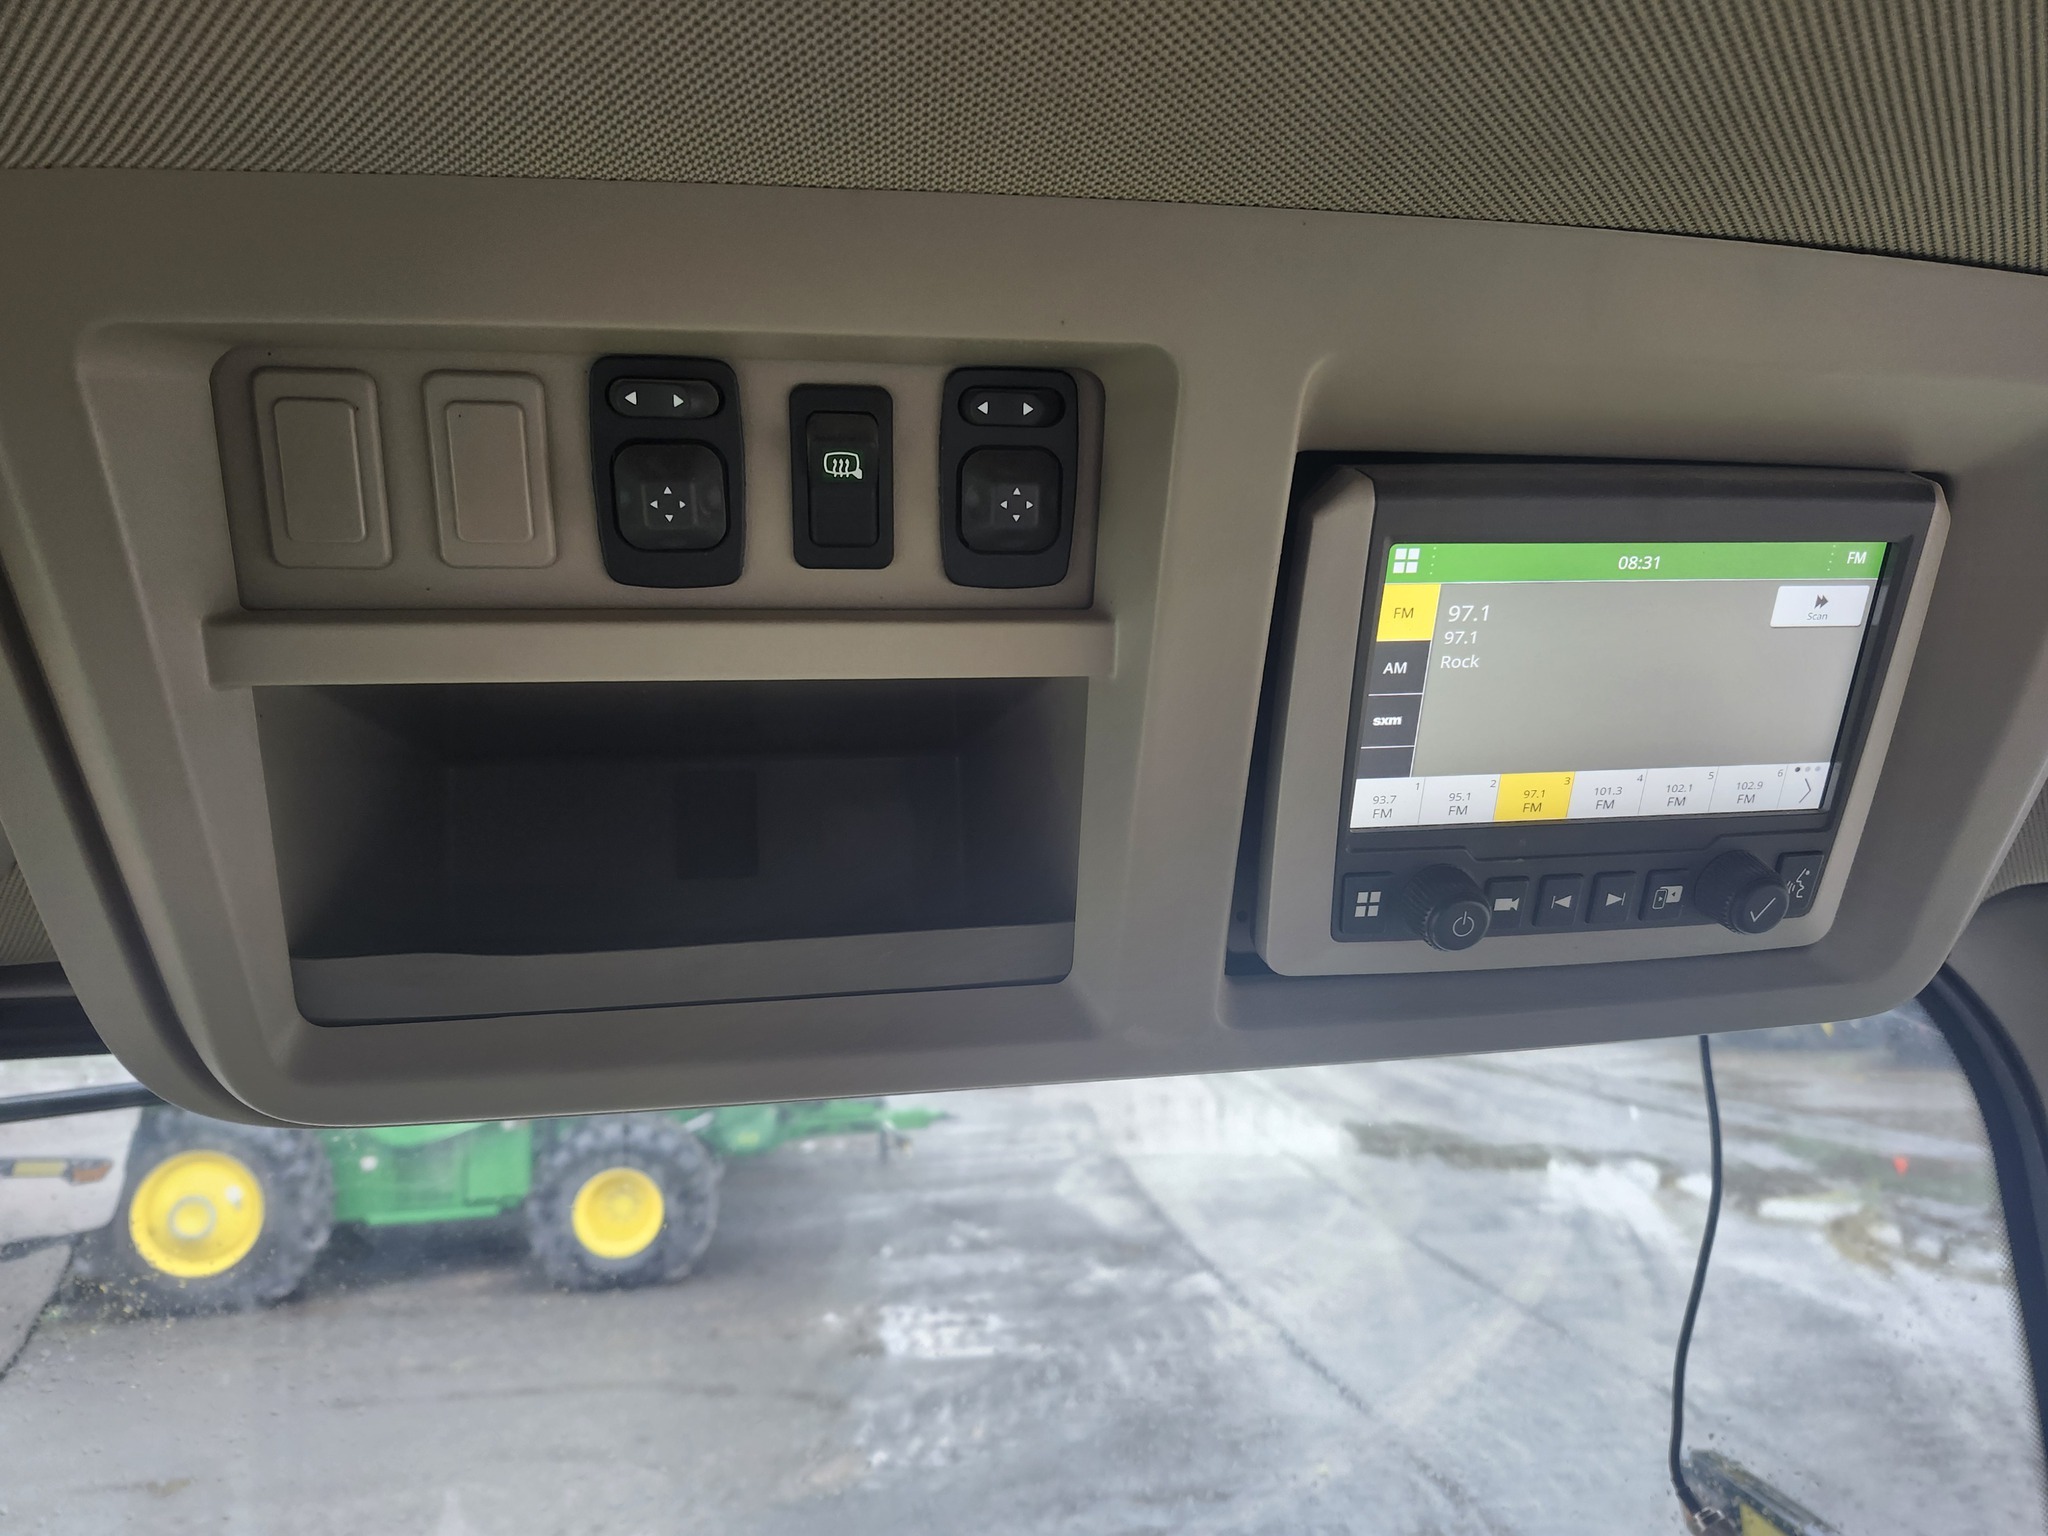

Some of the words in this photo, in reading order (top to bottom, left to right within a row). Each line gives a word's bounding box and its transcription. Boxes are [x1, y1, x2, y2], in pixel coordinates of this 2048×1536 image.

[1617, 555, 1662, 570] 08:31
[1846, 551, 1867, 565] FM
[1392, 607, 1415, 619] FM
[1447, 604, 1491, 622] 97.1
[1806, 610, 1829, 621] Scan
[1443, 630, 1479, 645] 97.1
[1440, 653, 1480, 669] Rock
[1382, 661, 1408, 675] AM
[1372, 716, 1402, 726] sxm
[1665, 784, 1693, 794] 102.1
[1735, 780, 1763, 791] 102.9
[1448, 791, 1472, 802] 95.1
[1523, 789, 1546, 800] 97.1
[1593, 786, 1623, 797] 101.3
[1372, 794, 1397, 806] 93.7
[1667, 796, 1686, 807] FM
[1736, 793, 1756, 804] FM
[1448, 804, 1468, 816] FM
[1523, 802, 1542, 813] FM
[1595, 799, 1615, 810] FM
[1372, 808, 1393, 819] FM
